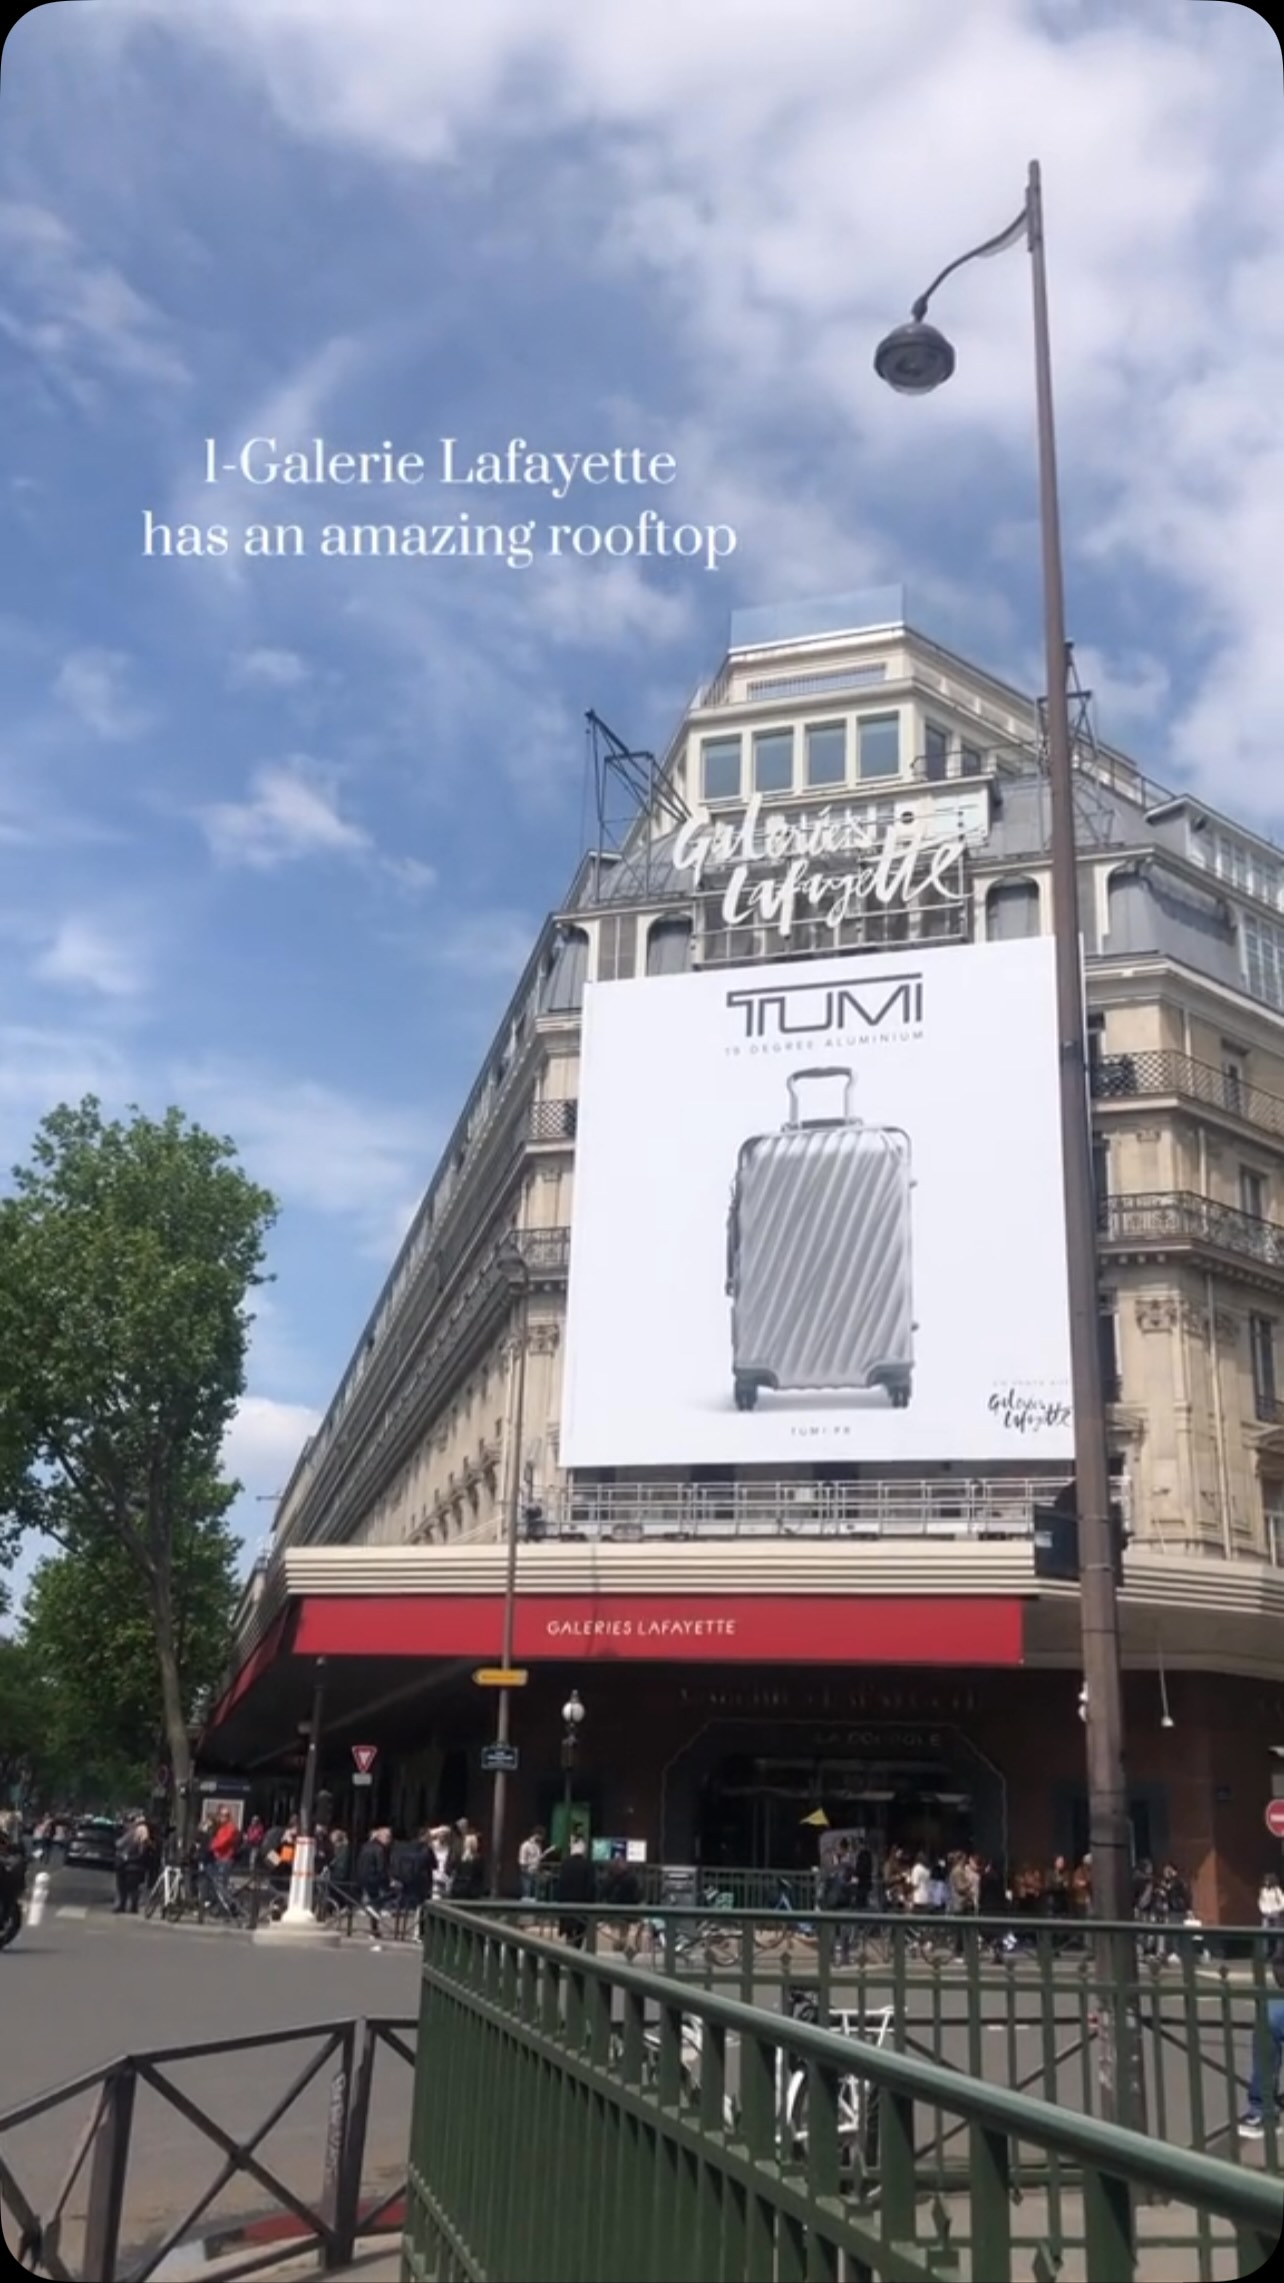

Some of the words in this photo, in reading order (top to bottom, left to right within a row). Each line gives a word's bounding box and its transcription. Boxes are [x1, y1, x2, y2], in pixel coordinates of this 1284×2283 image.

[673, 792, 874, 885] Galeries
[722, 824, 976, 937] Lafayette
[726, 972, 924, 1038] TUMI
[749, 1039, 815, 1055] DEGREE
[824, 1030, 925, 1047] ALUMINIUM
[546, 1619, 632, 1636] GALERIES
[637, 1619, 737, 1636] LAFAYETTE
